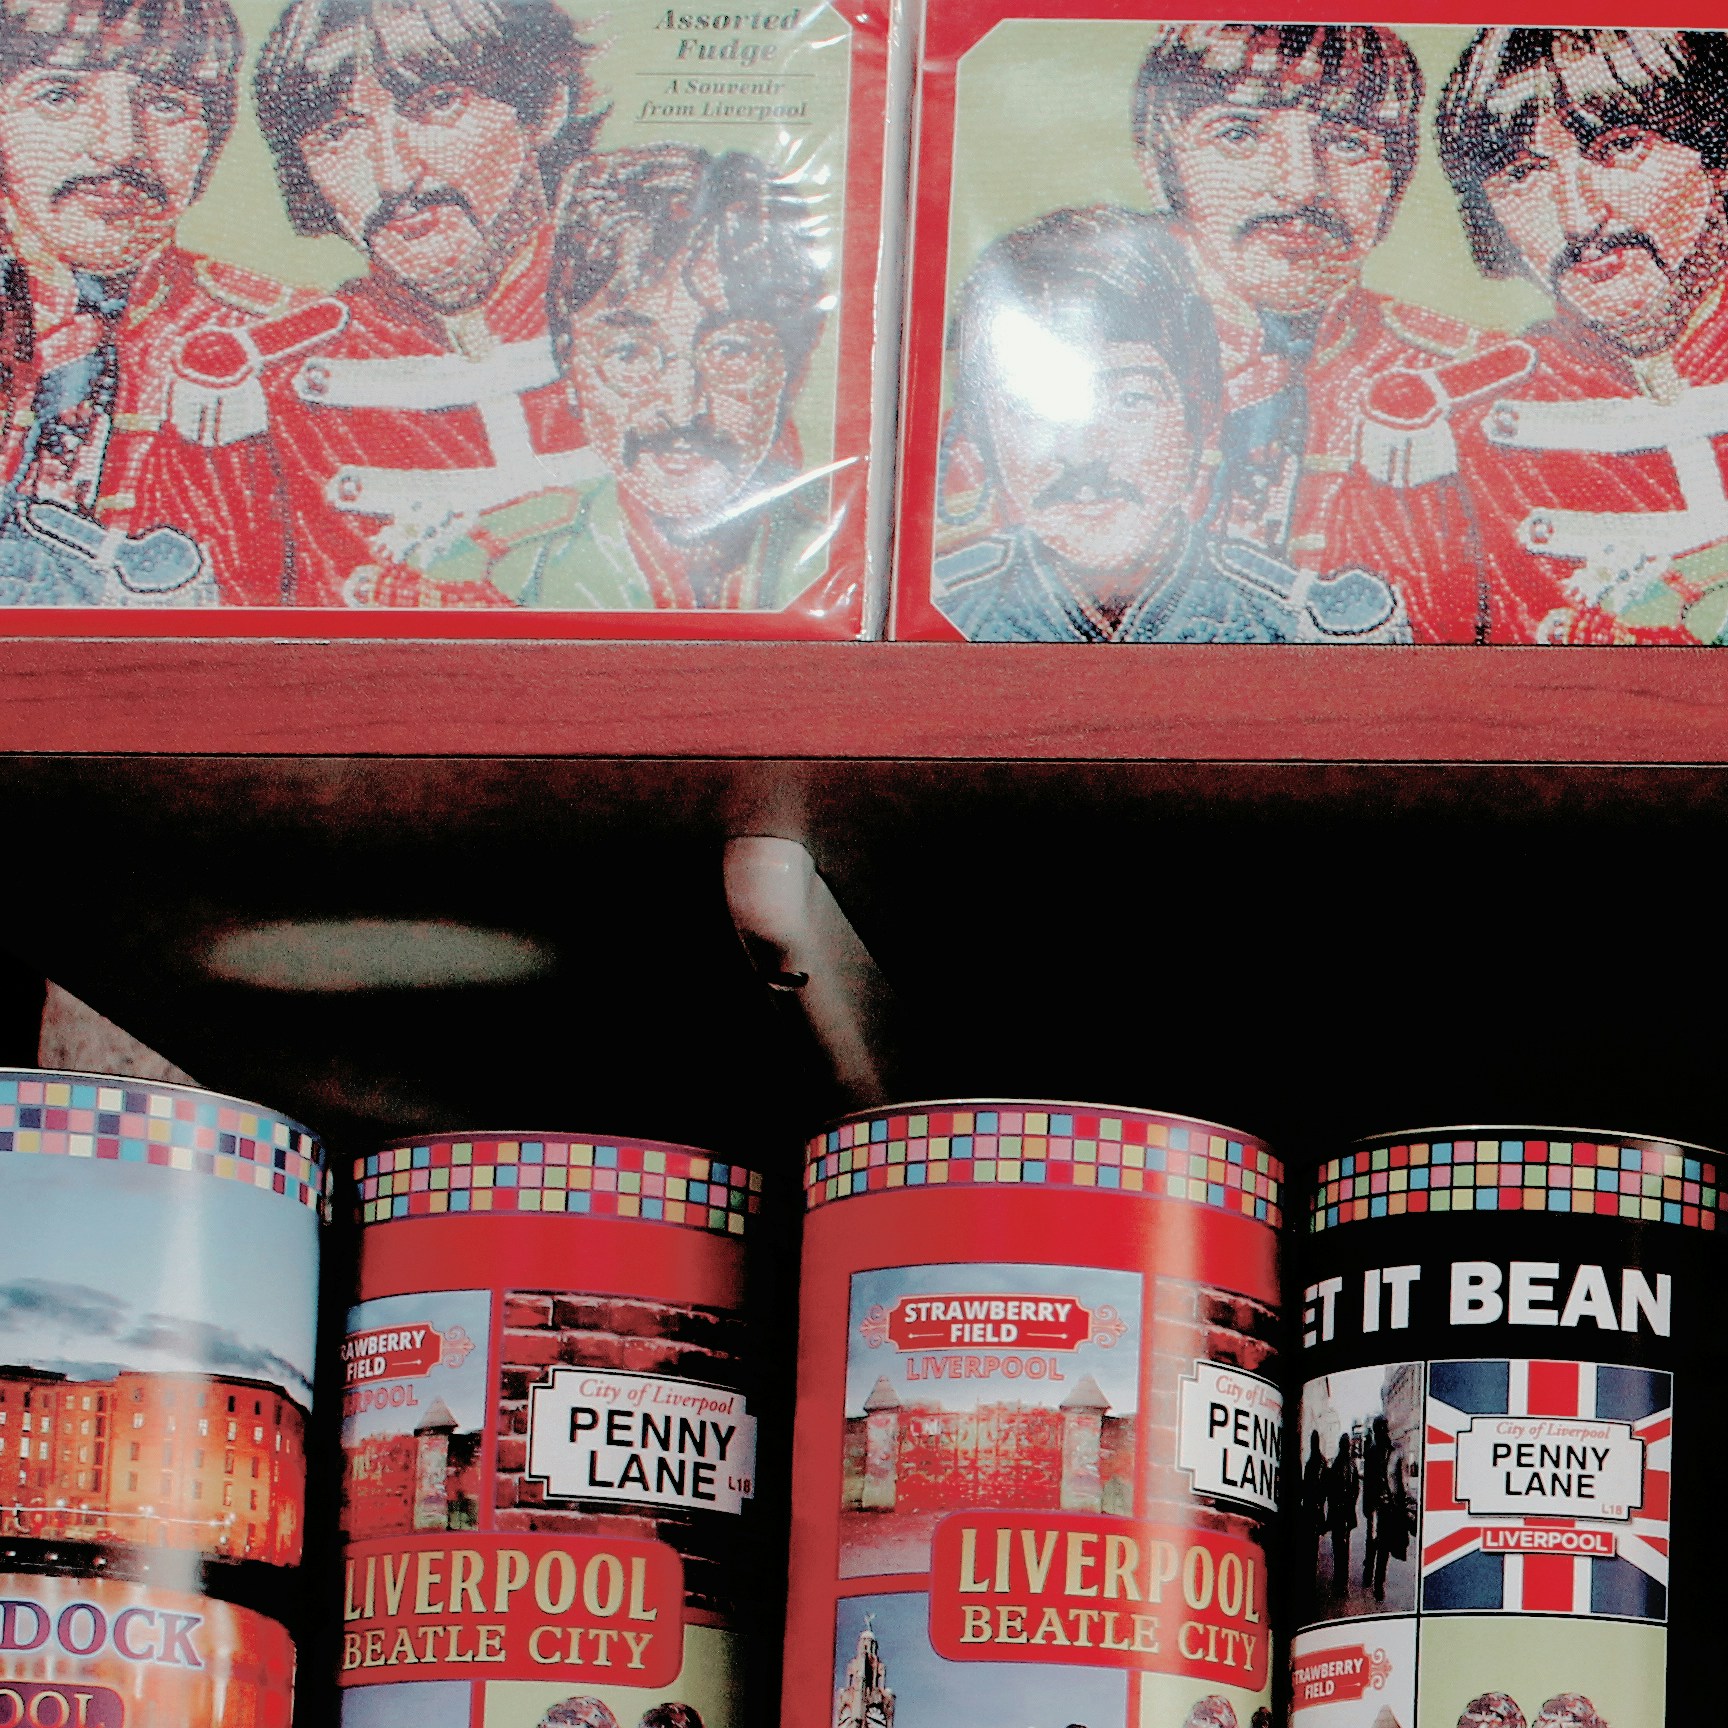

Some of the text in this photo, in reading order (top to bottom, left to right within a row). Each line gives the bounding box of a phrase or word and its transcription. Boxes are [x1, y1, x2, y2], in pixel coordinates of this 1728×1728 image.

[654, 9, 801, 30] Assorted
[676, 39, 778, 67] Fudge
[1363, 1261, 1671, 1337] IT BEAN
[905, 1301, 1072, 1324] STRAWBERRY
[950, 1323, 1018, 1342] FIELD
[347, 1356, 386, 1382] FIELD
[906, 1357, 1064, 1381] LIVERPOOL
[579, 1379, 735, 1415] City of Liverpool
[570, 1407, 736, 1461] PENNY
[1496, 1421, 1611, 1440] City of Liverpool
[1492, 1443, 1611, 1472] PENNY
[589, 1450, 716, 1501] LANE
[728, 1475, 751, 1494] L18
[1505, 1472, 1596, 1498] LANE
[1601, 1504, 1623, 1515] L18
[1486, 1531, 1607, 1552] LIVERPOOL
[344, 1549, 658, 1623] LIVERPOOL
[959, 1528, 1259, 1624] LIVERPOOL
[342, 1625, 653, 1670] BEATLE CITY
[960, 1605, 1256, 1671] BEATLE CITY
[1305, 1680, 1335, 1700] FIELD
